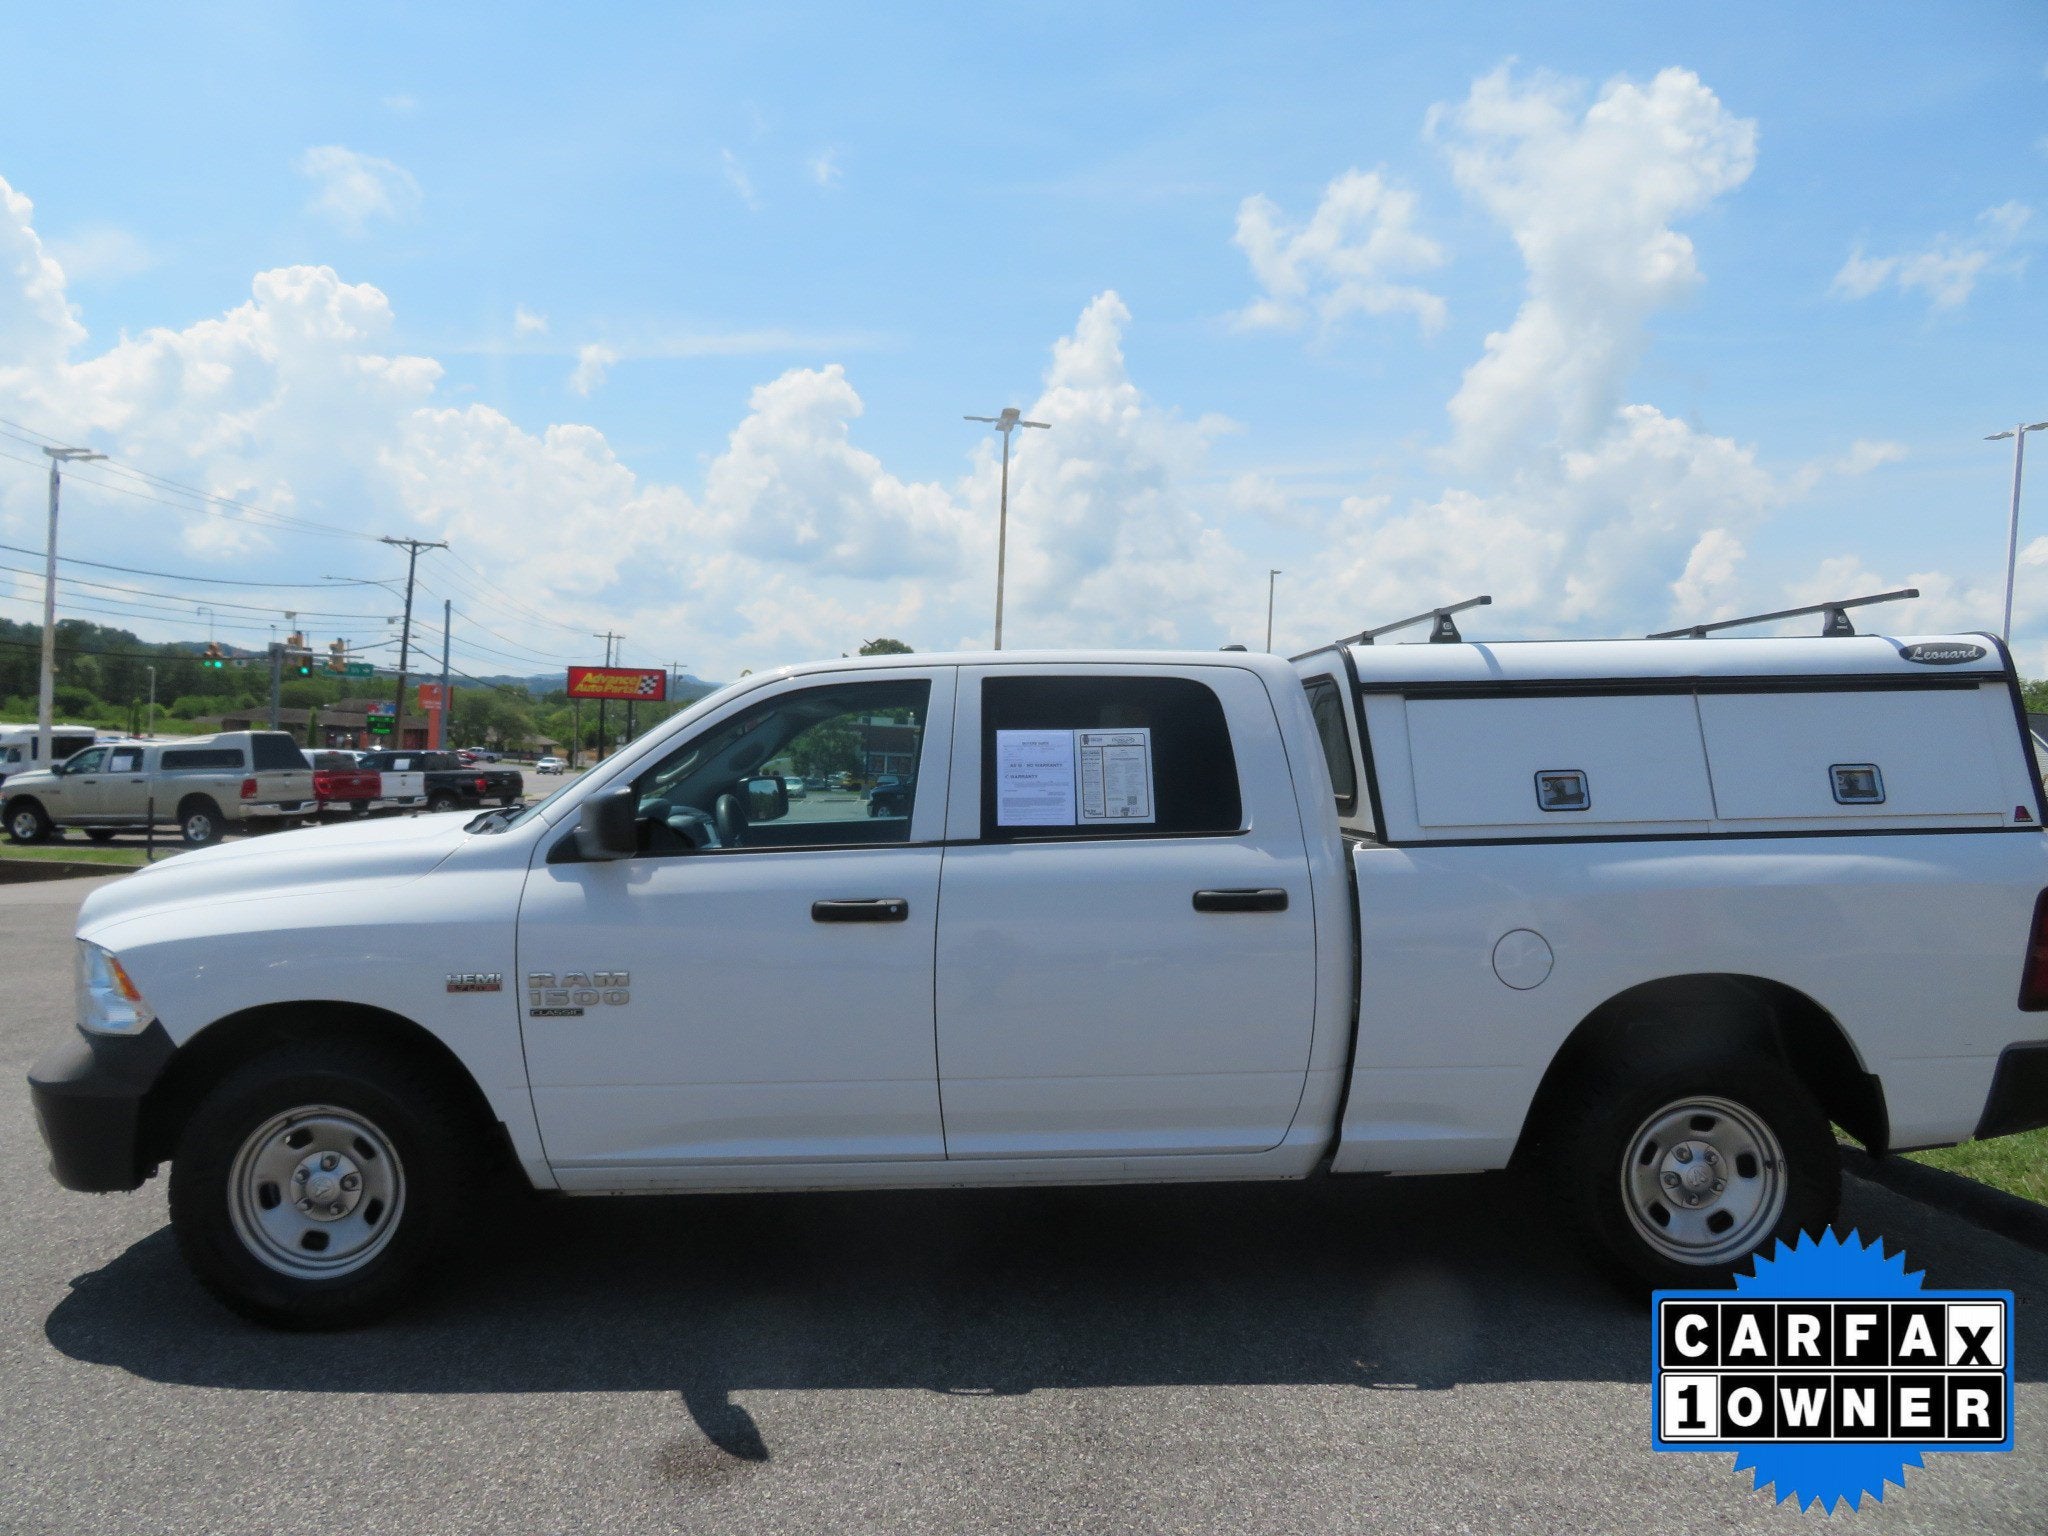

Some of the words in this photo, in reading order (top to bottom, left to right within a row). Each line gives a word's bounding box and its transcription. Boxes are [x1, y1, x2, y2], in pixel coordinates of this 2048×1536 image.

[1910, 646, 1980, 661] Leonard
[581, 672, 638, 684] Advance
[574, 683, 603, 692] Auto
[604, 684, 634, 694] Parts
[446, 973, 501, 984] HEMI
[528, 971, 630, 988] RAM
[529, 989, 630, 1006] 1500
